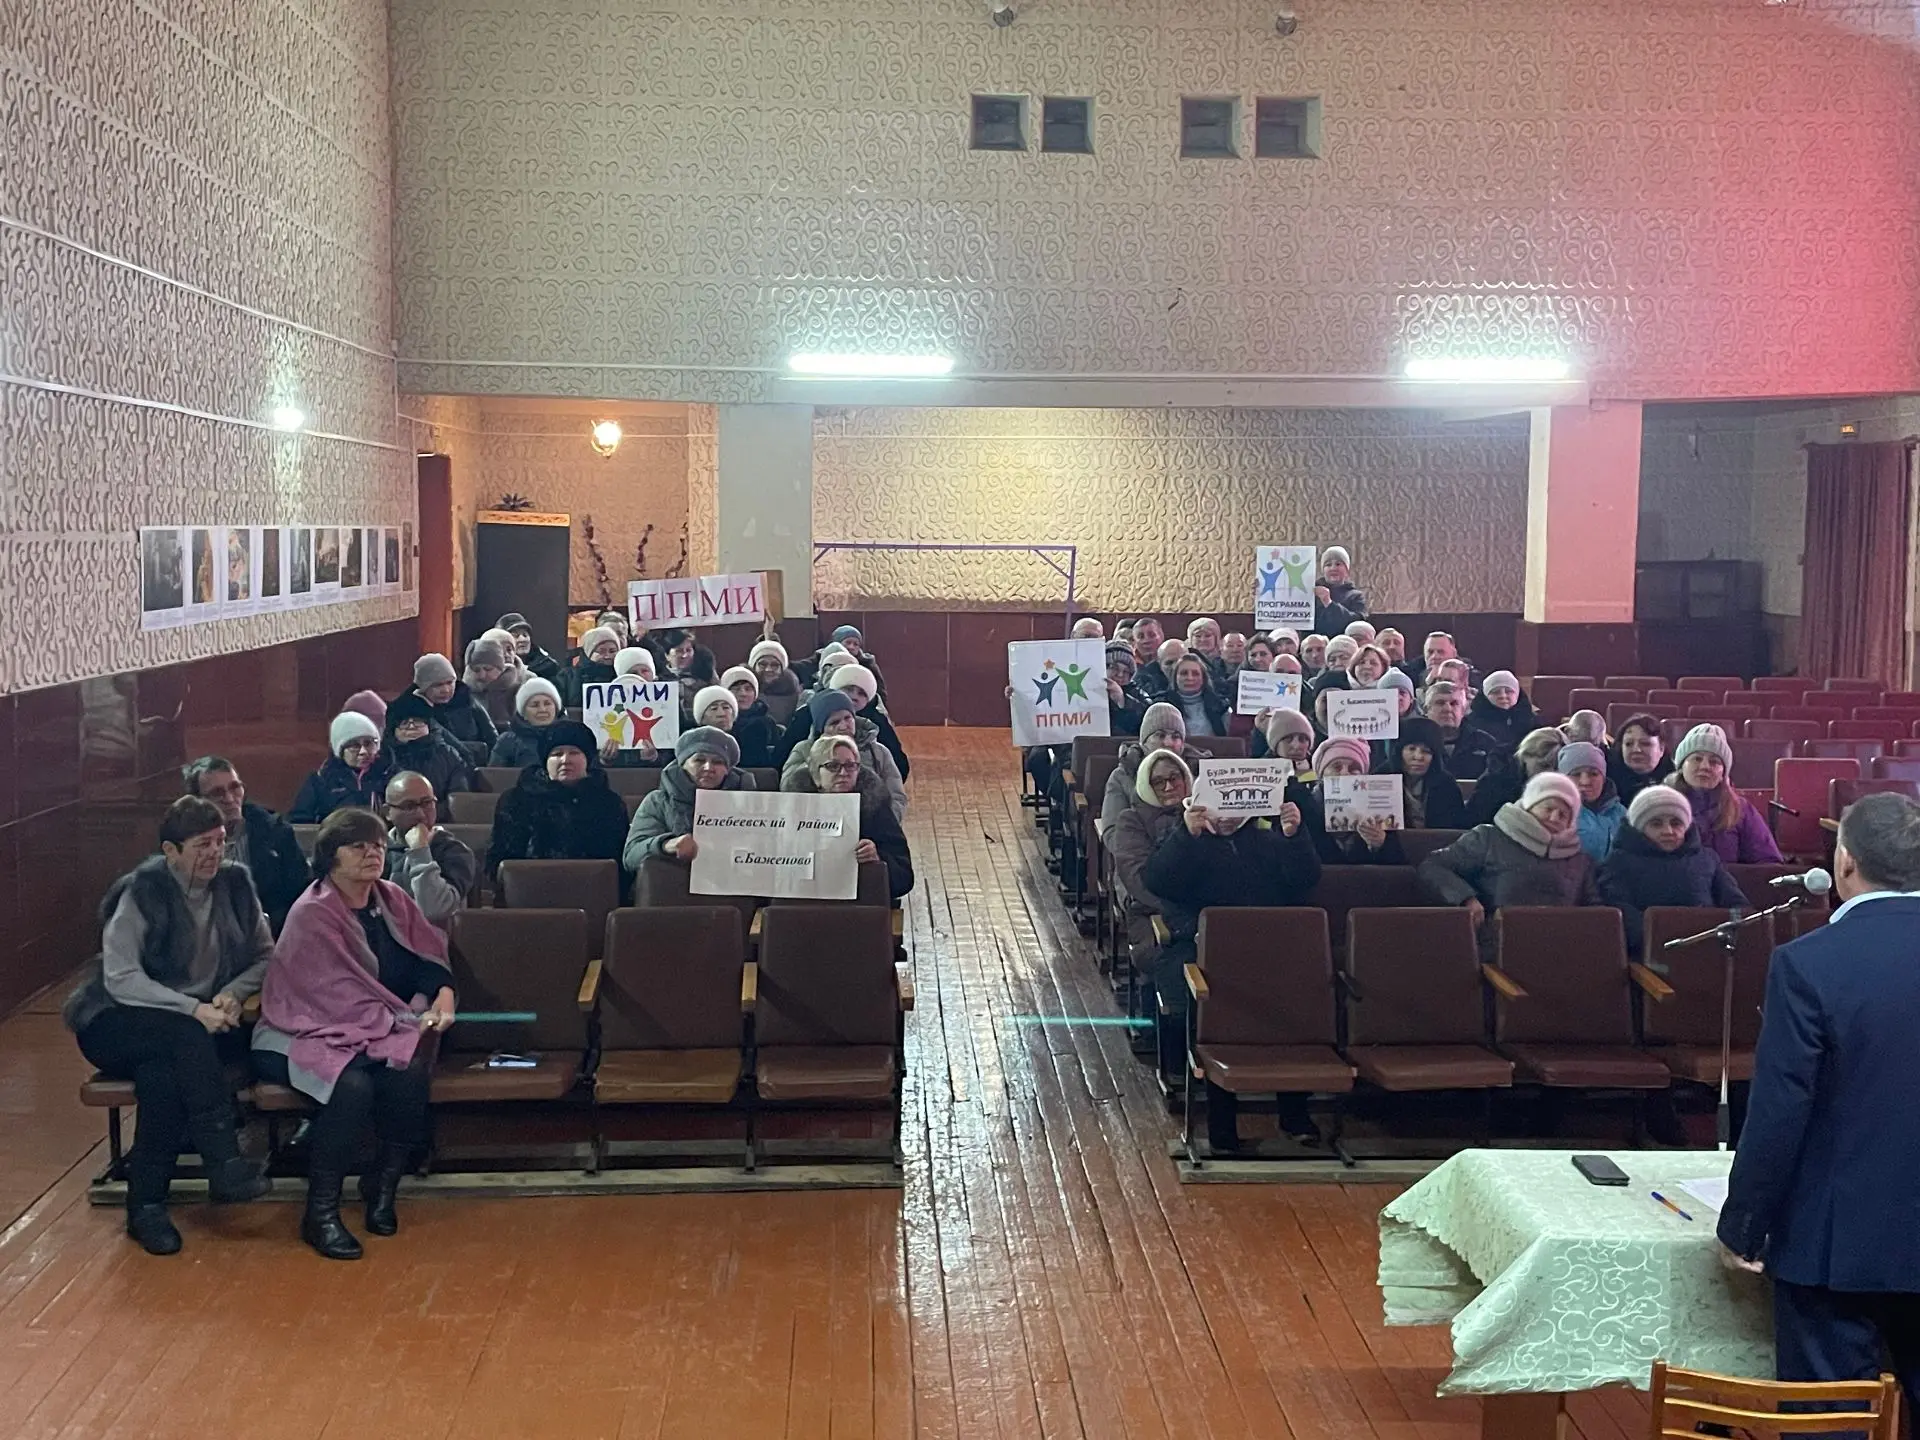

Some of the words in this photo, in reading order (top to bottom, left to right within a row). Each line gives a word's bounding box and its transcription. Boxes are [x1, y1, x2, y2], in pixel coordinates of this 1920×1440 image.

[632, 586, 760, 622] ППМИ
[1257, 600, 1311, 608] ПРОГРАММА
[586, 683, 669, 709] ППМИ
[1036, 711, 1092, 728] ППМИ
[1206, 769, 1228, 777] Будь
[797, 818, 840, 831] район,
